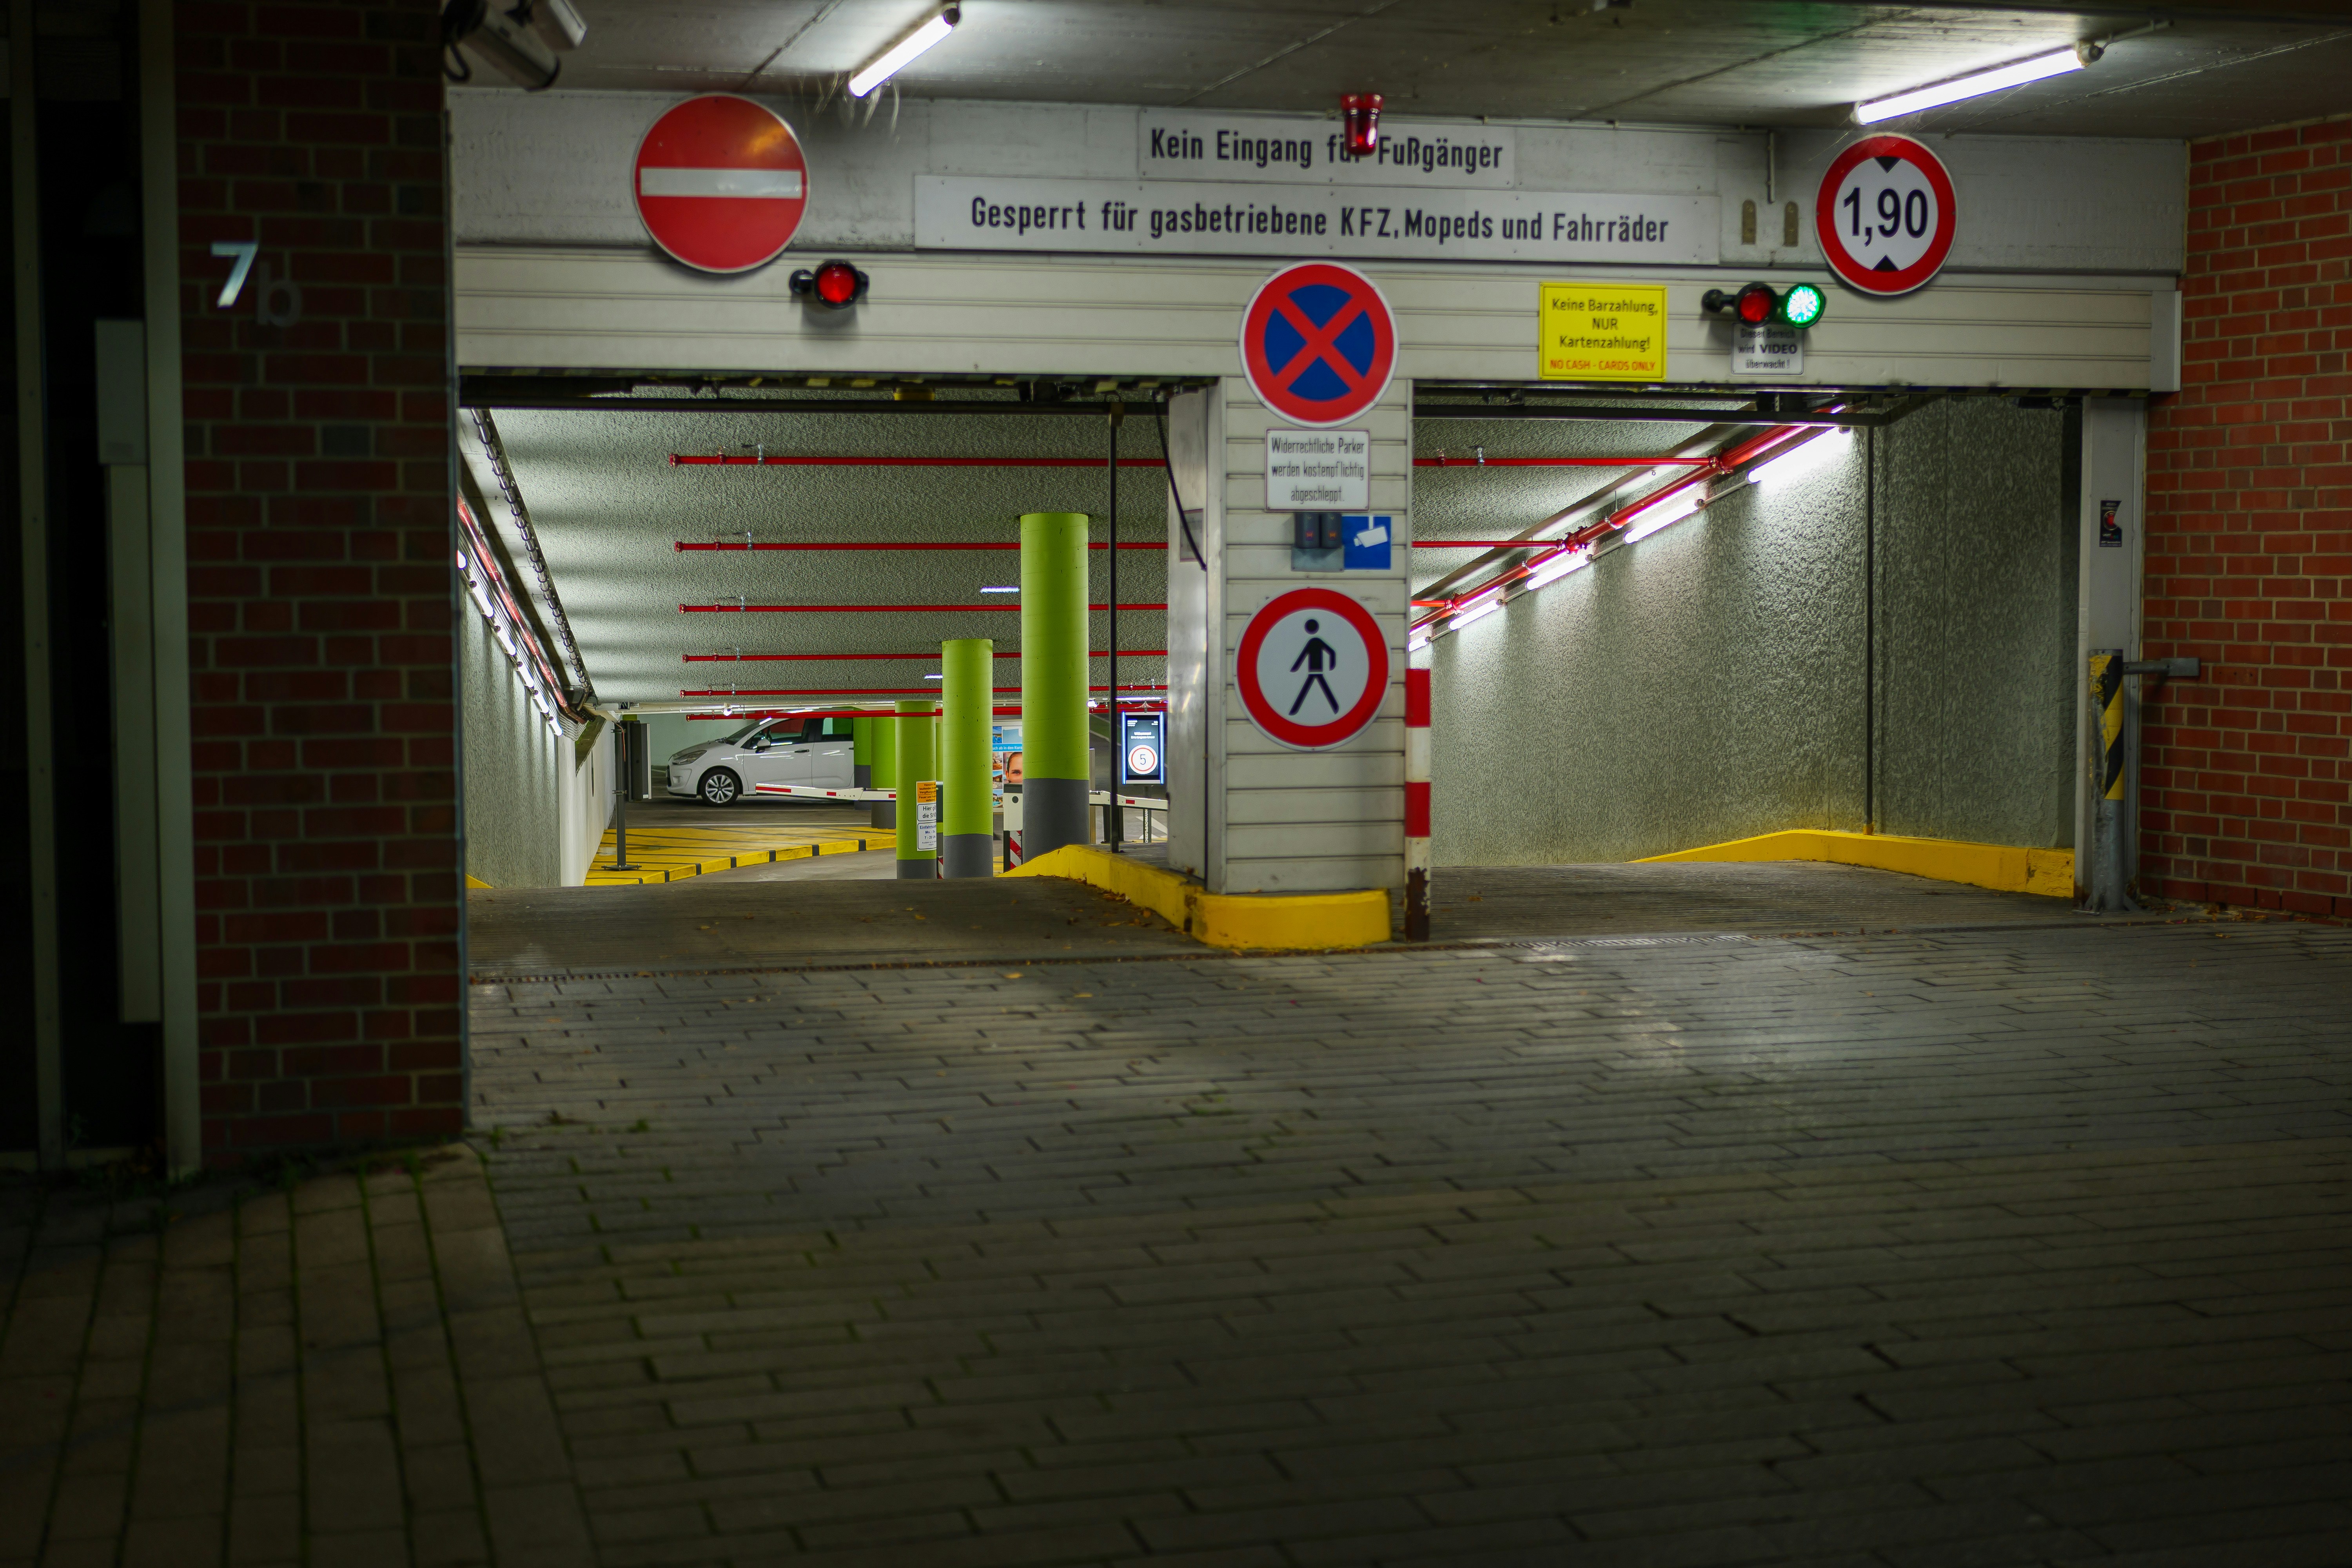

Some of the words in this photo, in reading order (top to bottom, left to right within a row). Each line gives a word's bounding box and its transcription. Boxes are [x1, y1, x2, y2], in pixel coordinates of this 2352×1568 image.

[1151, 128, 1203, 159] Kein
[1216, 129, 1312, 169] Eingang
[1327, 134, 1359, 163] fü
[1378, 135, 1503, 174] Fußgänger
[972, 197, 1085, 235] Gesperrt
[1102, 201, 1138, 231] für
[1151, 202, 1327, 239] gasbetriebene
[1502, 212, 1542, 240] und
[1553, 212, 1669, 242] Fahrräder
[1843, 187, 1928, 247] 1,90
[1552, 298, 1585, 311] Keine
[1588, 299, 1658, 316] Barzahlung,
[1592, 318, 1618, 330] NUR
[1560, 335, 1650, 352] Kartenzahlung!
[1739, 343, 1755, 354] wird
[1759, 344, 1798, 354] VIDEO
[1550, 359, 1564, 369] NO
[1566, 359, 1591, 370] CASH
[1599, 360, 1629, 371] CARDS
[1632, 361, 1656, 371] ONLY
[1271, 437, 1334, 454] Widerrechtliche
[1338, 438, 1364, 454] Parker
[1272, 461, 1299, 477] werden
[1303, 461, 1364, 480] kostenpflichtig
[1140, 754, 1146, 765] 5
